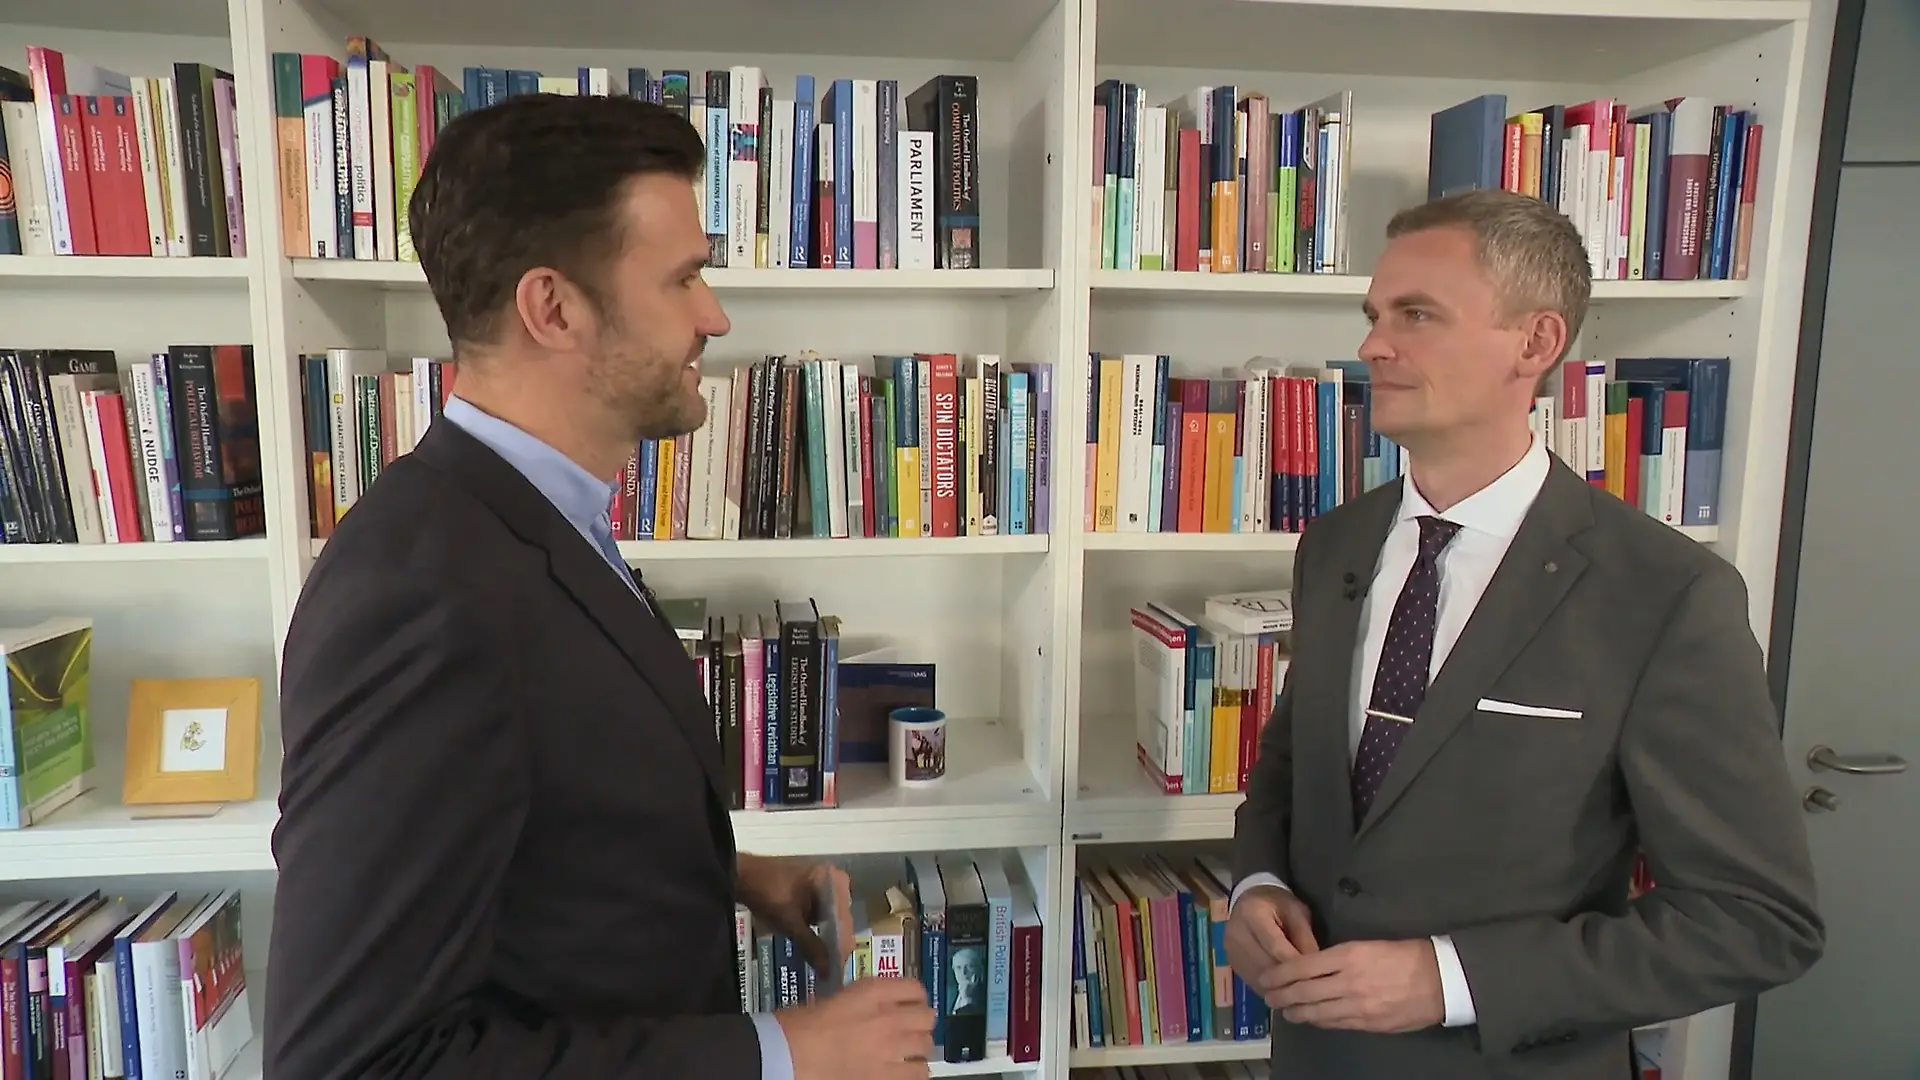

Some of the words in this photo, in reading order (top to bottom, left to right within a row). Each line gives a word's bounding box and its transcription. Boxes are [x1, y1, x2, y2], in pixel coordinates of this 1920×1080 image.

[951, 102, 962, 169] COMPARATIVE
[354, 164, 367, 204] politics
[1709, 152, 1720, 190] triumph
[909, 138, 924, 243] PARLIAMENT
[953, 169, 962, 212] POLITICS
[1681, 212, 1692, 247] FORSCHUNG
[69, 358, 99, 374] GAME
[185, 379, 199, 428] POLITICAL
[197, 385, 207, 399] The
[366, 388, 380, 429] Patterns
[936, 393, 954, 424] SPIN
[198, 401, 210, 427] Oxford
[336, 406, 346, 449] COMPARATIVE
[144, 439, 159, 483] NUDGE
[201, 427, 214, 463] Handbook
[338, 450, 346, 474] POLICY
[936, 428, 954, 498] DICTATORS
[339, 473, 347, 503] AGENDAS
[765, 673, 779, 721] Legislative
[799, 673, 808, 698] Oxford
[767, 721, 778, 765] Leviathan
[790, 711, 799, 745] STUDIES
[995, 905, 1008, 942] British
[789, 971, 798, 984] MY
[878, 956, 898, 971] ALL
[994, 944, 1007, 985] Politics
